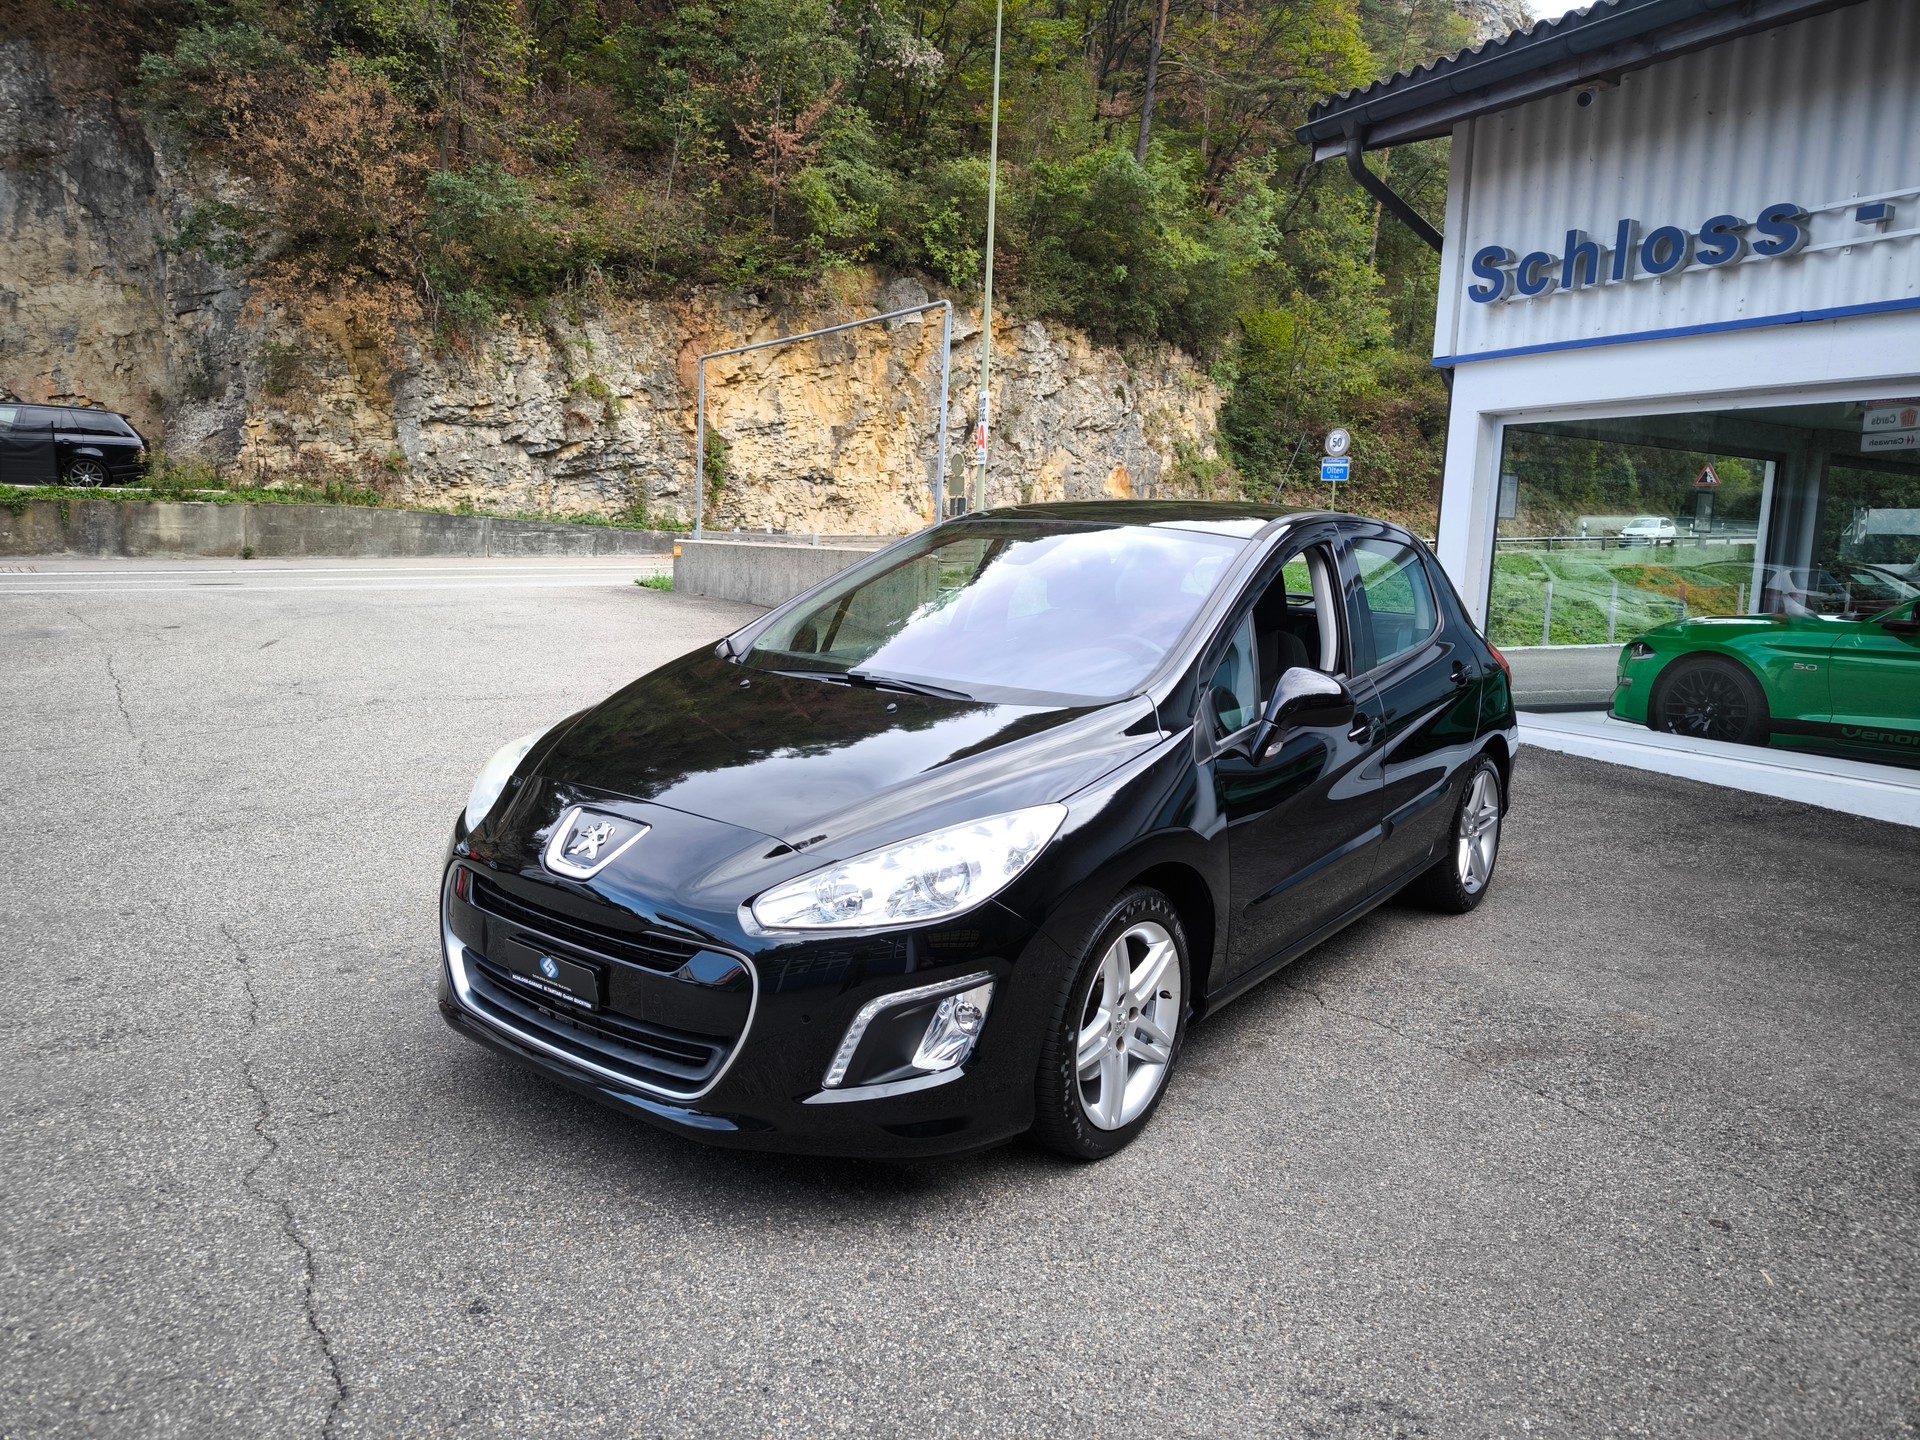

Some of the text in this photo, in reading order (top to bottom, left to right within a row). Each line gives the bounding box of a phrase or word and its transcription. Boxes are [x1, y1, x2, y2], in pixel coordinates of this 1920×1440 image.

[1467, 202, 1808, 304] Schloss
[1332, 437, 1342, 448] 50
[1326, 466, 1344, 474] Olten
